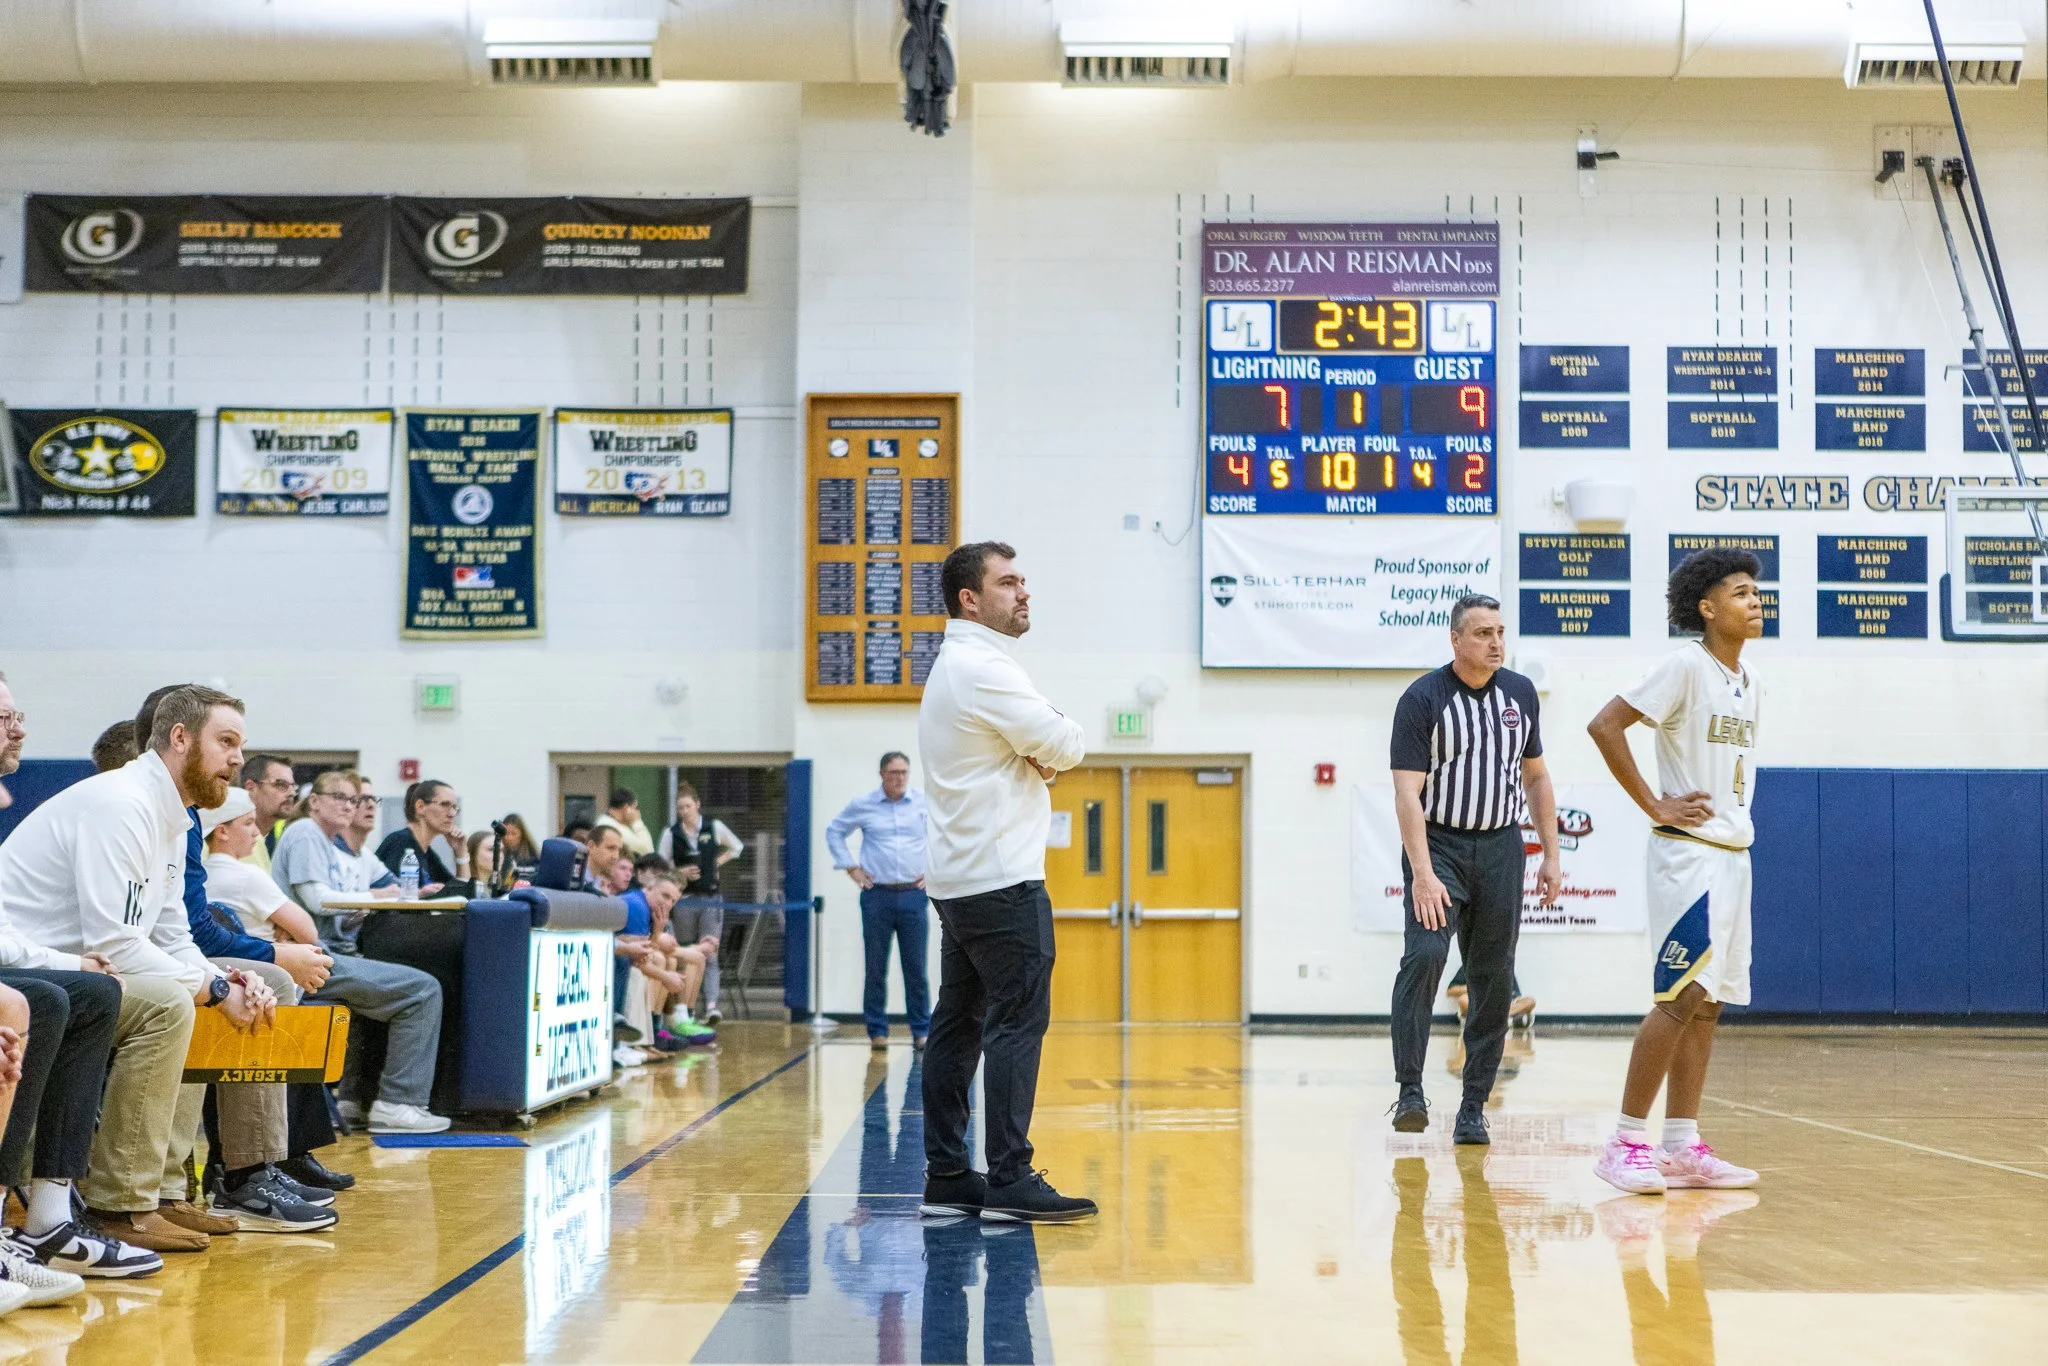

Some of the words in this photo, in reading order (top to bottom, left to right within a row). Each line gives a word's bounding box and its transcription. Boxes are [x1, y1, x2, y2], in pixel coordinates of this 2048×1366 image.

[543, 224, 627, 240] QUINCEY
[629, 225, 712, 240] NOONAN
[1208, 232, 1237, 241] ORAL
[1240, 232, 1287, 242] SURGERY
[1298, 232, 1346, 242] WISDOM
[1350, 232, 1383, 242] TEETH
[1398, 232, 1440, 242] DENTAL
[1442, 232, 1497, 242] IMPLANTS
[543, 257, 571, 268] GIRLS
[572, 258, 628, 268] BASKETBALL
[630, 259, 664, 269] PLAYER
[666, 260, 679, 269] OF
[681, 259, 699, 268] THE
[700, 259, 725, 268] YEAR
[1214, 251, 1258, 273] DR.
[1266, 251, 1335, 273] ALAN
[1347, 251, 1462, 273] REISMAN
[1464, 262, 1493, 273] DDS
[1208, 280, 1294, 292] 303.665.2377
[1393, 281, 1497, 293] alanreisman.com
[1315, 301, 1417, 348] 2:43
[1550, 355, 1600, 366] SOFTBALL
[1682, 351, 1714, 362] RYAN
[1717, 351, 1762, 362] DEAKIN
[1835, 352, 1905, 363] MARCHING
[1212, 357, 1321, 379] LIGHTNING
[1325, 369, 1377, 385] PERIOD
[1414, 357, 1483, 380] GUEST
[1674, 365, 1721, 375] WRESTLING
[1853, 366, 1888, 377] BAND
[1264, 386, 1288, 427] 7
[1352, 391, 1362, 424] 1
[1460, 386, 1485, 427] 9
[1541, 411, 1608, 423] SOFTBALL
[1690, 412, 1756, 423] SOFTBALL
[1835, 407, 1906, 419] MARCHING
[1853, 422, 1888, 432] BAND
[1210, 436, 1256, 452] FOULS
[1267, 446, 1294, 460] T.O.L.
[1302, 436, 1356, 452] PLAYER
[1364, 436, 1400, 452] FOUL
[1409, 447, 1437, 461] T.O.L.
[1446, 436, 1492, 452] FOULS
[266, 455, 342, 466] CHAMPIONSHIPS
[409, 450, 466, 462] NATIONAL
[471, 450, 538, 462] WRESTLING
[604, 455, 682, 467] CHAMPIONSHIPS
[427, 463, 459, 473] HALL
[464, 463, 480, 473] OF
[484, 463, 519, 473] FAME
[1228, 455, 1249, 486] 4
[1269, 459, 1289, 489] 5
[1322, 452, 1356, 490] 10
[1384, 455, 1394, 488] 1
[1413, 462, 1431, 487] 4
[1464, 454, 1484, 489] 2
[242, 468, 276, 489] 20
[332, 468, 368, 490] 09
[586, 469, 619, 490] 20
[677, 469, 706, 490] 13
[1696, 475, 1849, 512] STATE
[560, 501, 579, 513] ALL
[588, 501, 640, 513] AMERICAN
[655, 502, 684, 513] RYAN
[691, 501, 727, 513] DEAKIN
[1210, 497, 1257, 512] SCORE
[1326, 497, 1377, 513] MATCH
[1446, 497, 1493, 513] SCORE
[441, 526, 489, 538] SCHULTZ
[462, 541, 522, 552] WRESTLER
[1525, 537, 1567, 548] STEVE
[1570, 538, 1625, 549] ZIEGLER
[1674, 538, 1715, 549] STEVE
[1719, 538, 1774, 549] ZIEGLER
[1837, 539, 1907, 550] MARCHING
[1967, 541, 2023, 551] NICHOLAS
[434, 553, 450, 564] OF
[453, 553, 474, 564] THE
[477, 553, 508, 564] YEAR
[1559, 552, 1592, 562] GOLF
[1855, 553, 1890, 564] BAND
[1968, 556, 2032, 565] WRESTLING
[1374, 558, 1416, 574] Proud
[1418, 558, 1473, 578] Sponsor
[1475, 558, 1491, 574] of
[1391, 584, 1438, 604] Legacy
[1540, 592, 1610, 604] MARCHING
[1837, 594, 1907, 605] MARCHING
[1379, 609, 1424, 627] School
[1557, 607, 1592, 618] BAND
[1855, 608, 1890, 619] BAND
[413, 615, 470, 626] NATIONAL
[472, 615, 527, 626] CHAMPION
[1561, 622, 1588, 632] 2007
[1118, 713, 1143, 732] EXIT
[1546, 904, 1563, 912] the
[1569, 916, 1596, 925] Team
[557, 942, 592, 1006] LEGACY
[546, 1017, 598, 1092] LIGHTNING
[219, 1070, 287, 1082] LEGACY
